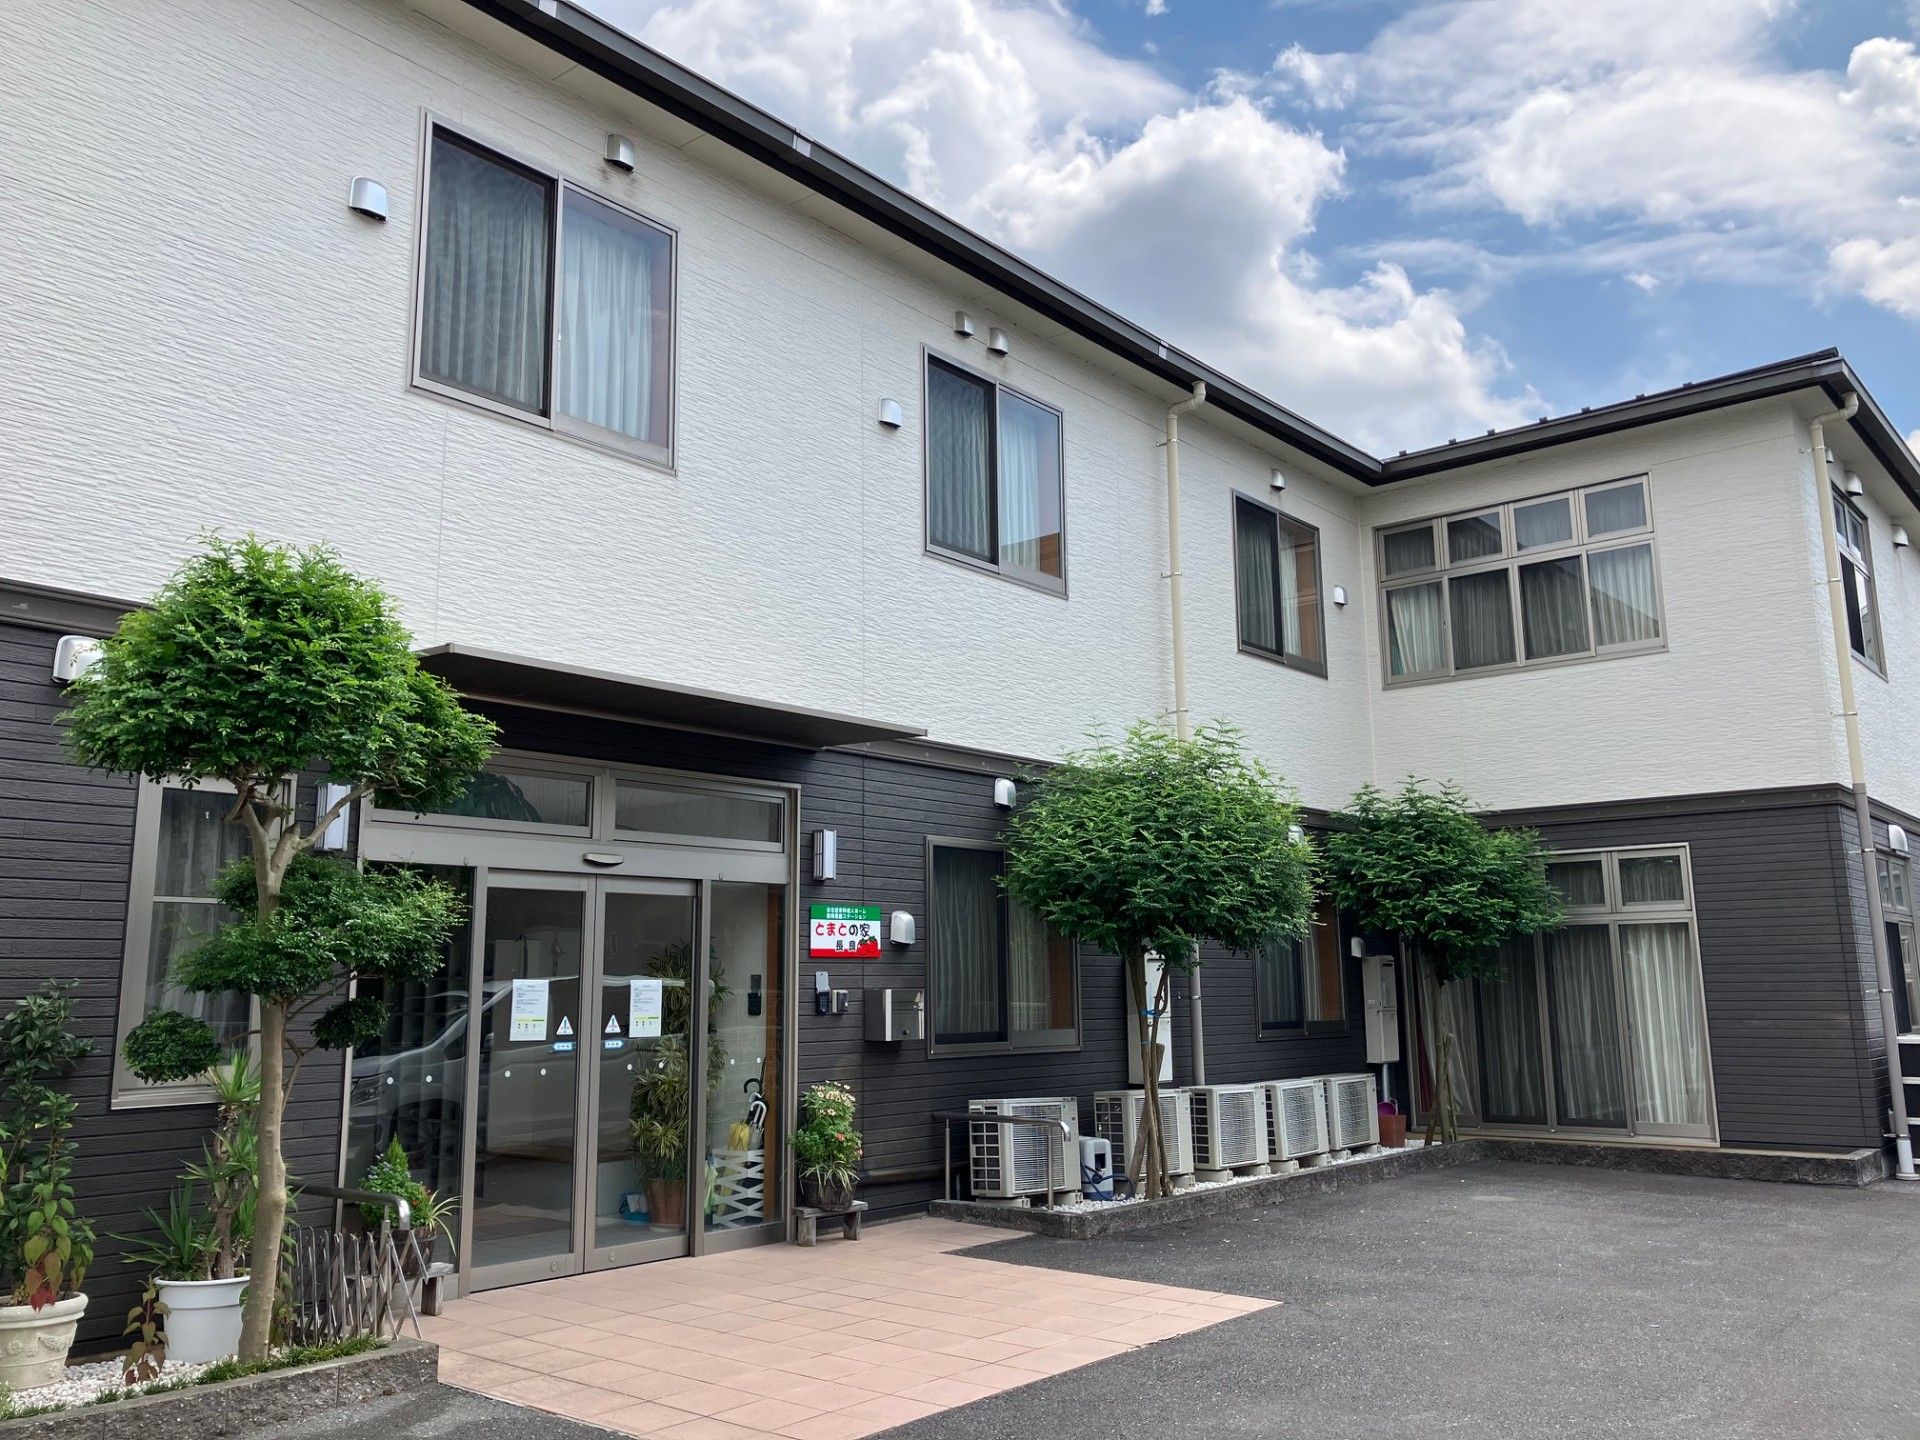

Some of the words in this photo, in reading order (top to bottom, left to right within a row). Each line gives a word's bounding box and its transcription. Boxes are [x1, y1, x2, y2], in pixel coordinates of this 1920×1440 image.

[816, 922, 870, 937] とまとの家
